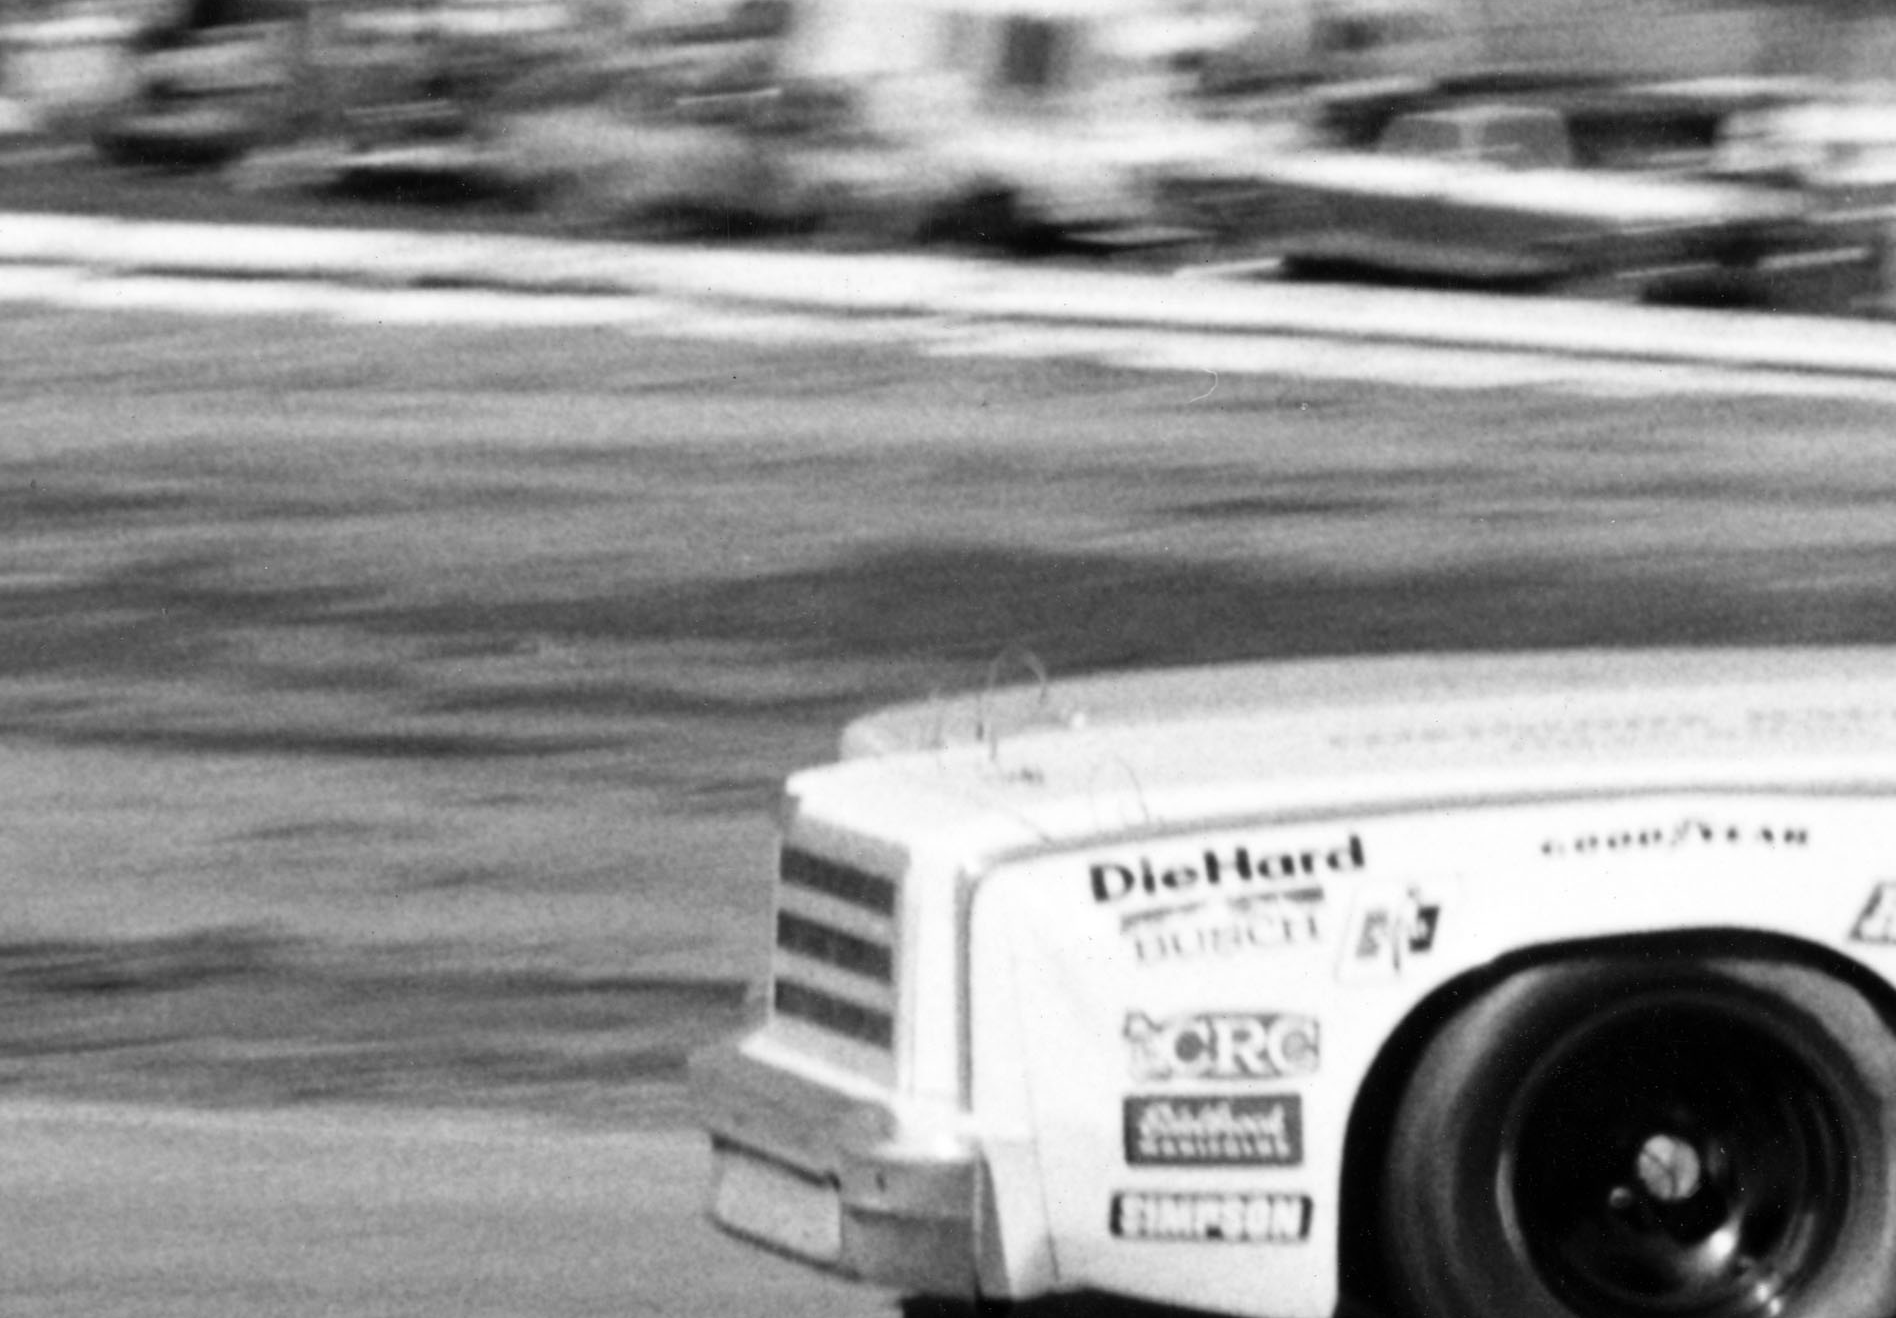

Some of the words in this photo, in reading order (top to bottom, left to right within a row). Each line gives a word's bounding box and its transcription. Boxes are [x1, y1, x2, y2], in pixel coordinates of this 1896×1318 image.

[1089, 834, 1366, 904] DieHard
[1167, 1012, 1318, 1080] CRC
[1121, 1193, 1303, 1237] SIMPSON
